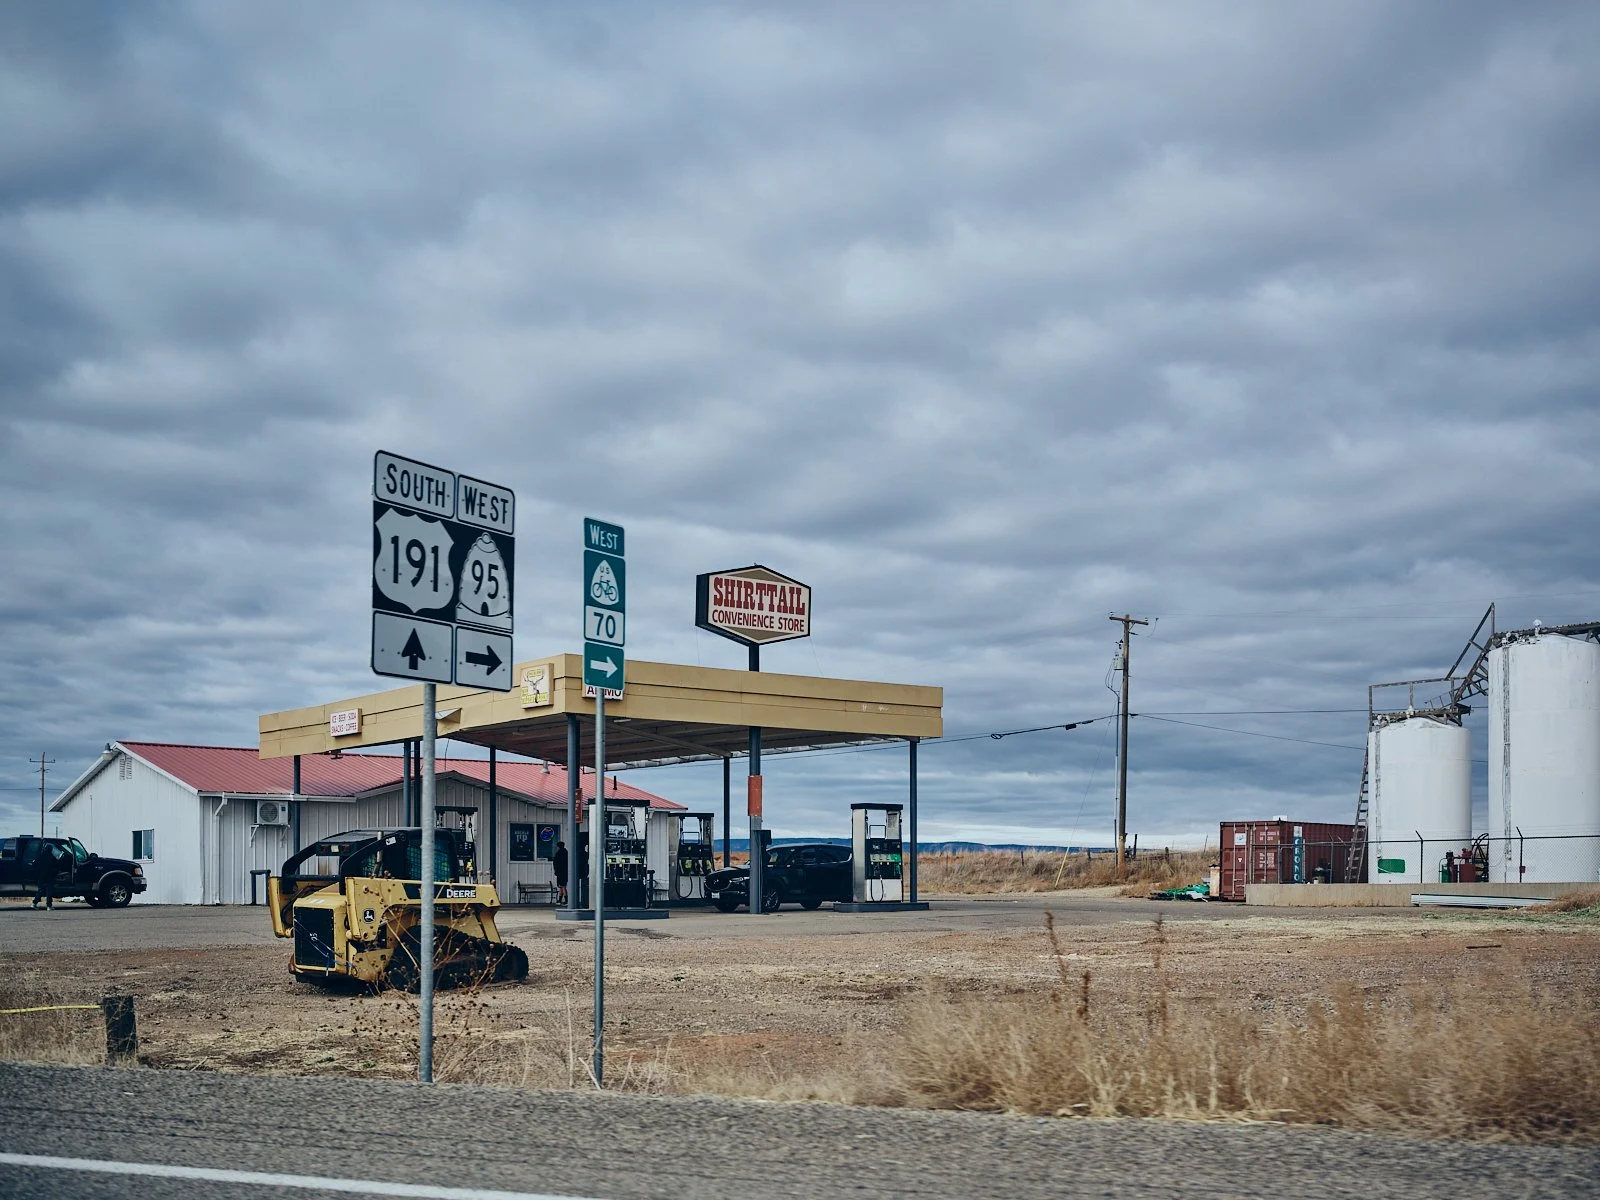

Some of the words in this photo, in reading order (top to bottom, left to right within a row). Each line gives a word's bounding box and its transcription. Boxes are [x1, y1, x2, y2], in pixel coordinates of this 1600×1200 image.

[385, 463, 446, 508] SOUTH
[464, 485, 509, 525] WEST
[590, 524, 618, 550] WEST
[391, 535, 439, 593] 191
[471, 559, 499, 600] 95
[713, 577, 805, 615] SHIRTTAIL
[593, 612, 616, 639] 70
[712, 609, 774, 629] CONVENIENCE
[778, 616, 805, 632] STORE
[1293, 838, 1301, 884] CRONO
[446, 888, 476, 898] DEERE
